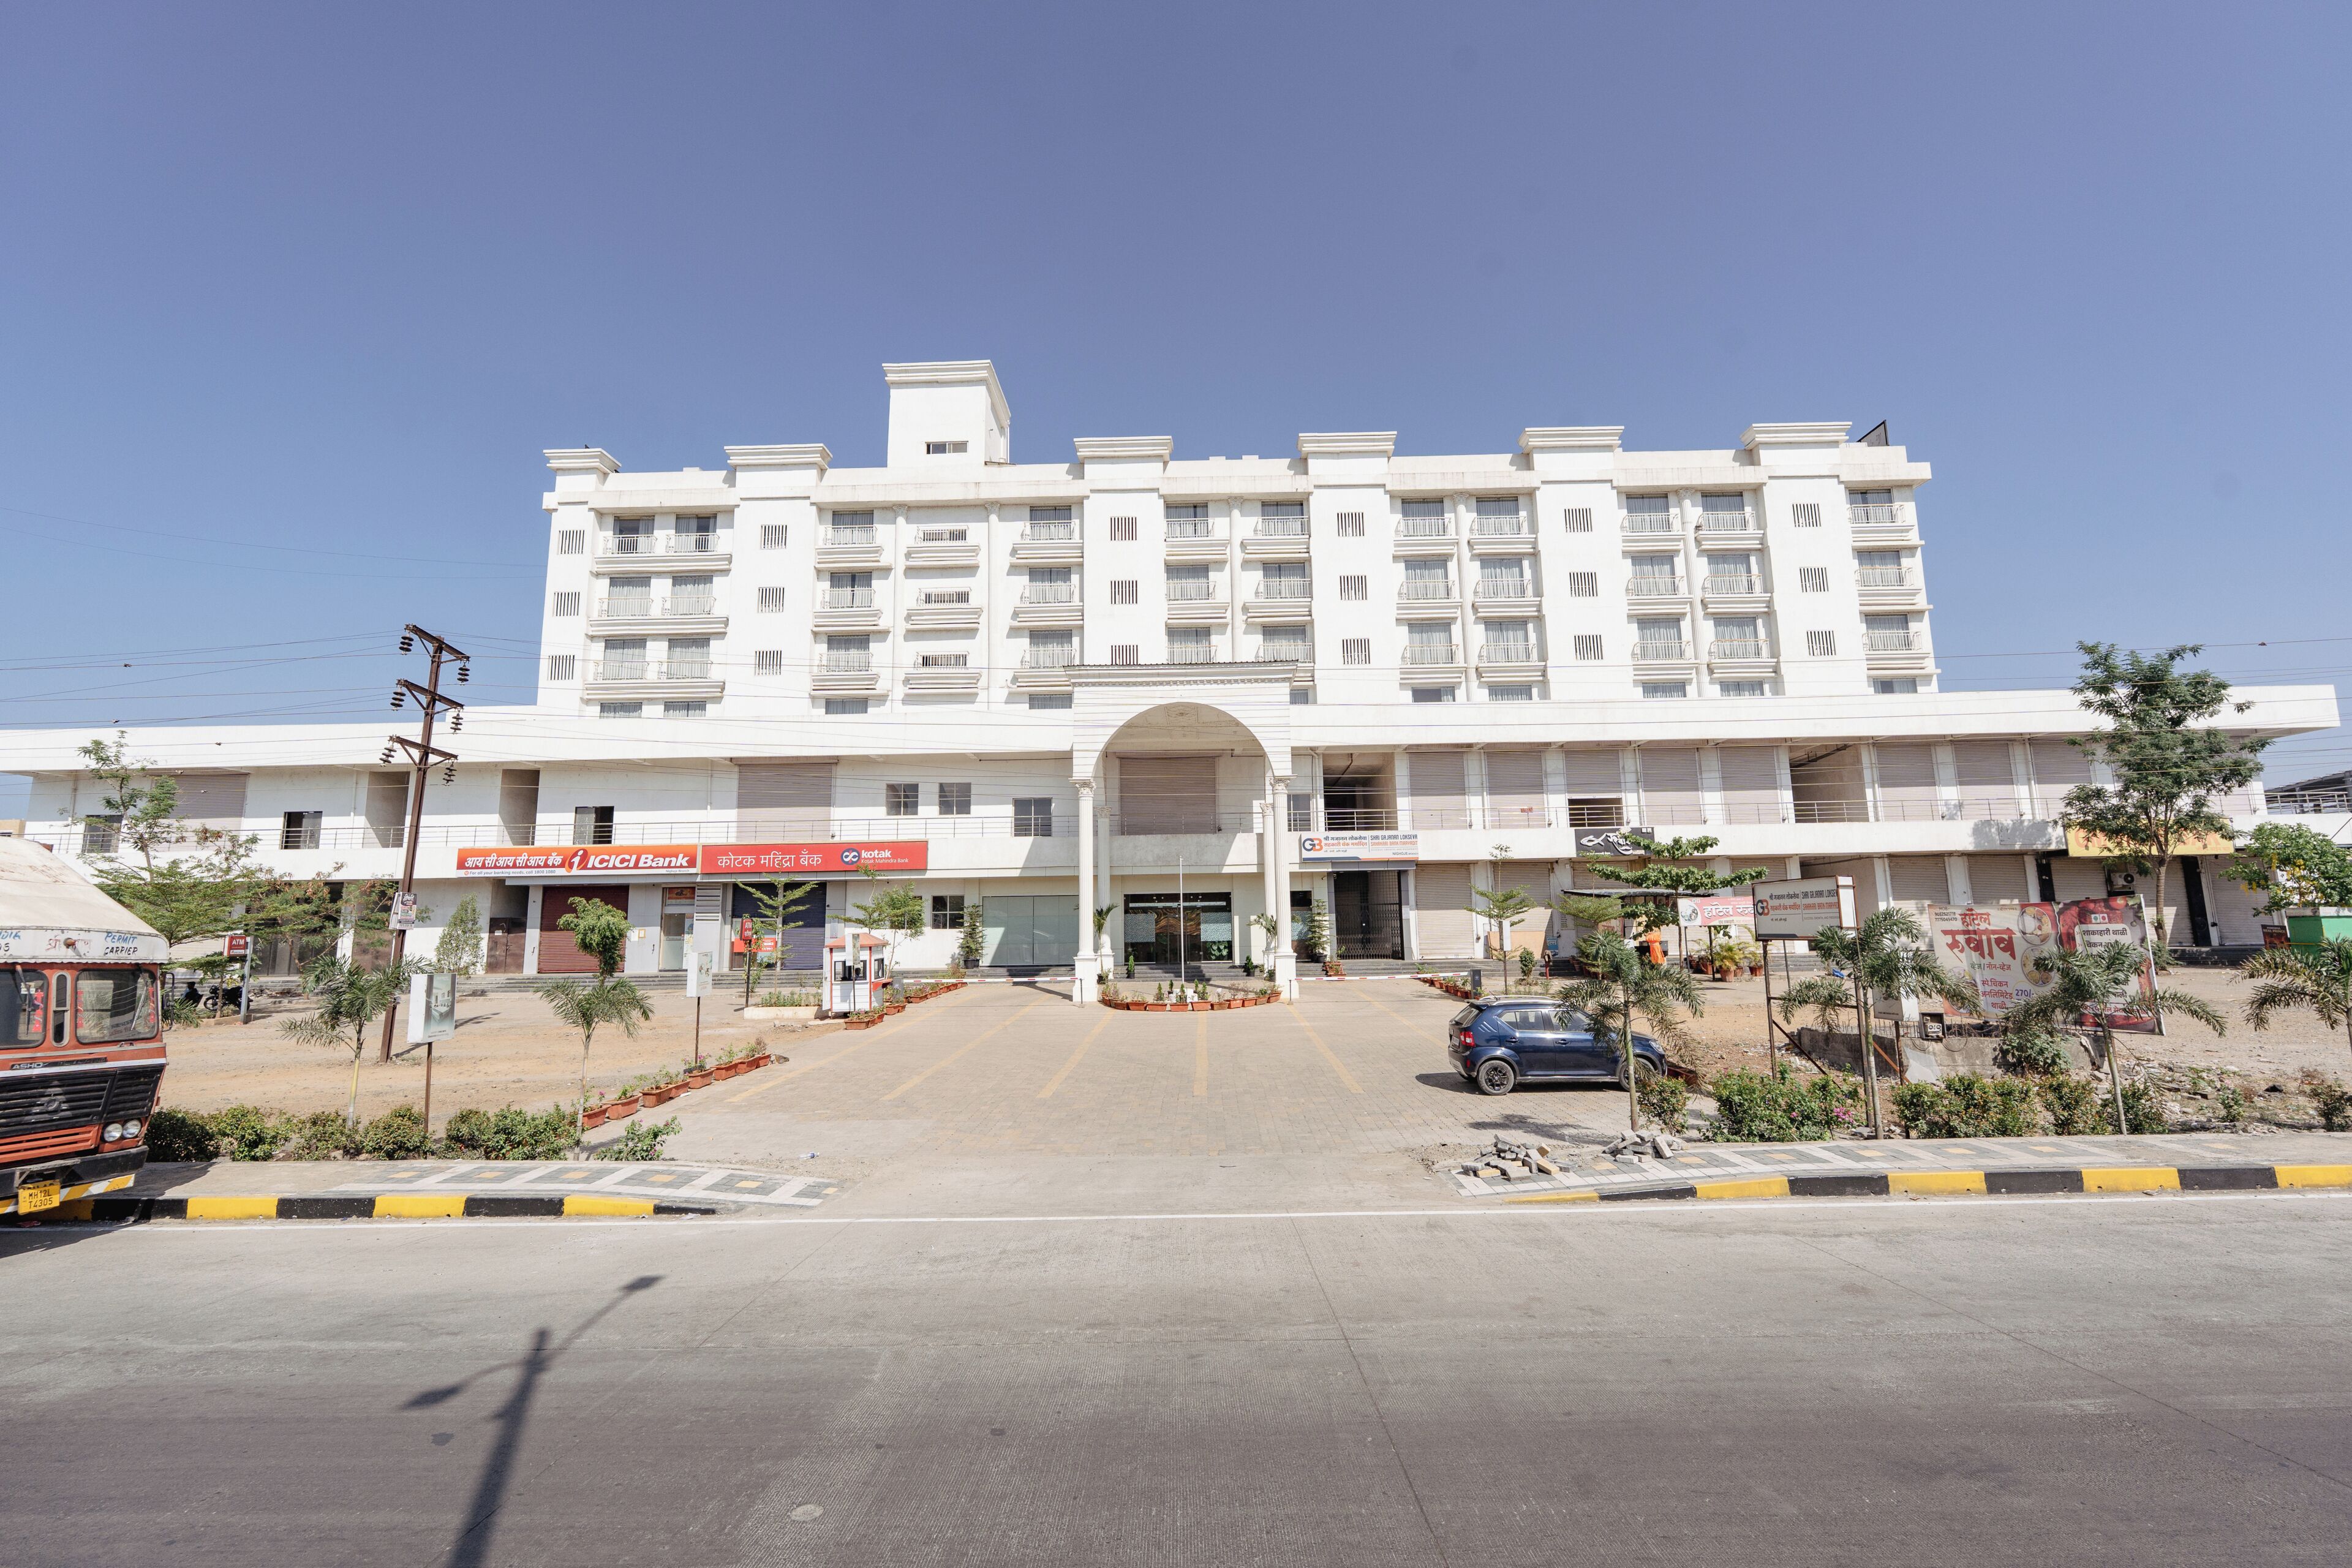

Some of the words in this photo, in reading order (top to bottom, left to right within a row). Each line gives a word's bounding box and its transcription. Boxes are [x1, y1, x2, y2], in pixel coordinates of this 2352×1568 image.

[465, 856, 485, 868] आय
[484, 853, 497, 867] सी
[496, 856, 514, 867] आय
[515, 853, 527, 867] सी
[527, 856, 546, 867] आय
[587, 854, 637, 868] ICICI
[638, 853, 690, 867] Bank
[717, 853, 756, 868] कोटक
[760, 851, 796, 868] महिंद्रा
[799, 849, 823, 867] बँक
[861, 850, 892, 858] kotak
[1756, 899, 1770, 916] GB
[1958, 908, 1991, 930] हॉटेल
[105, 931, 137, 944] PERMIT
[2082, 928, 2110, 937] शाकाहारी
[104, 946, 138, 956] CARRIER
[1940, 927, 2016, 963] रुबाब
[2015, 989, 2035, 998] 270/-
[28, 1188, 51, 1200] MH12L
[29, 1197, 53, 1209] T4305
